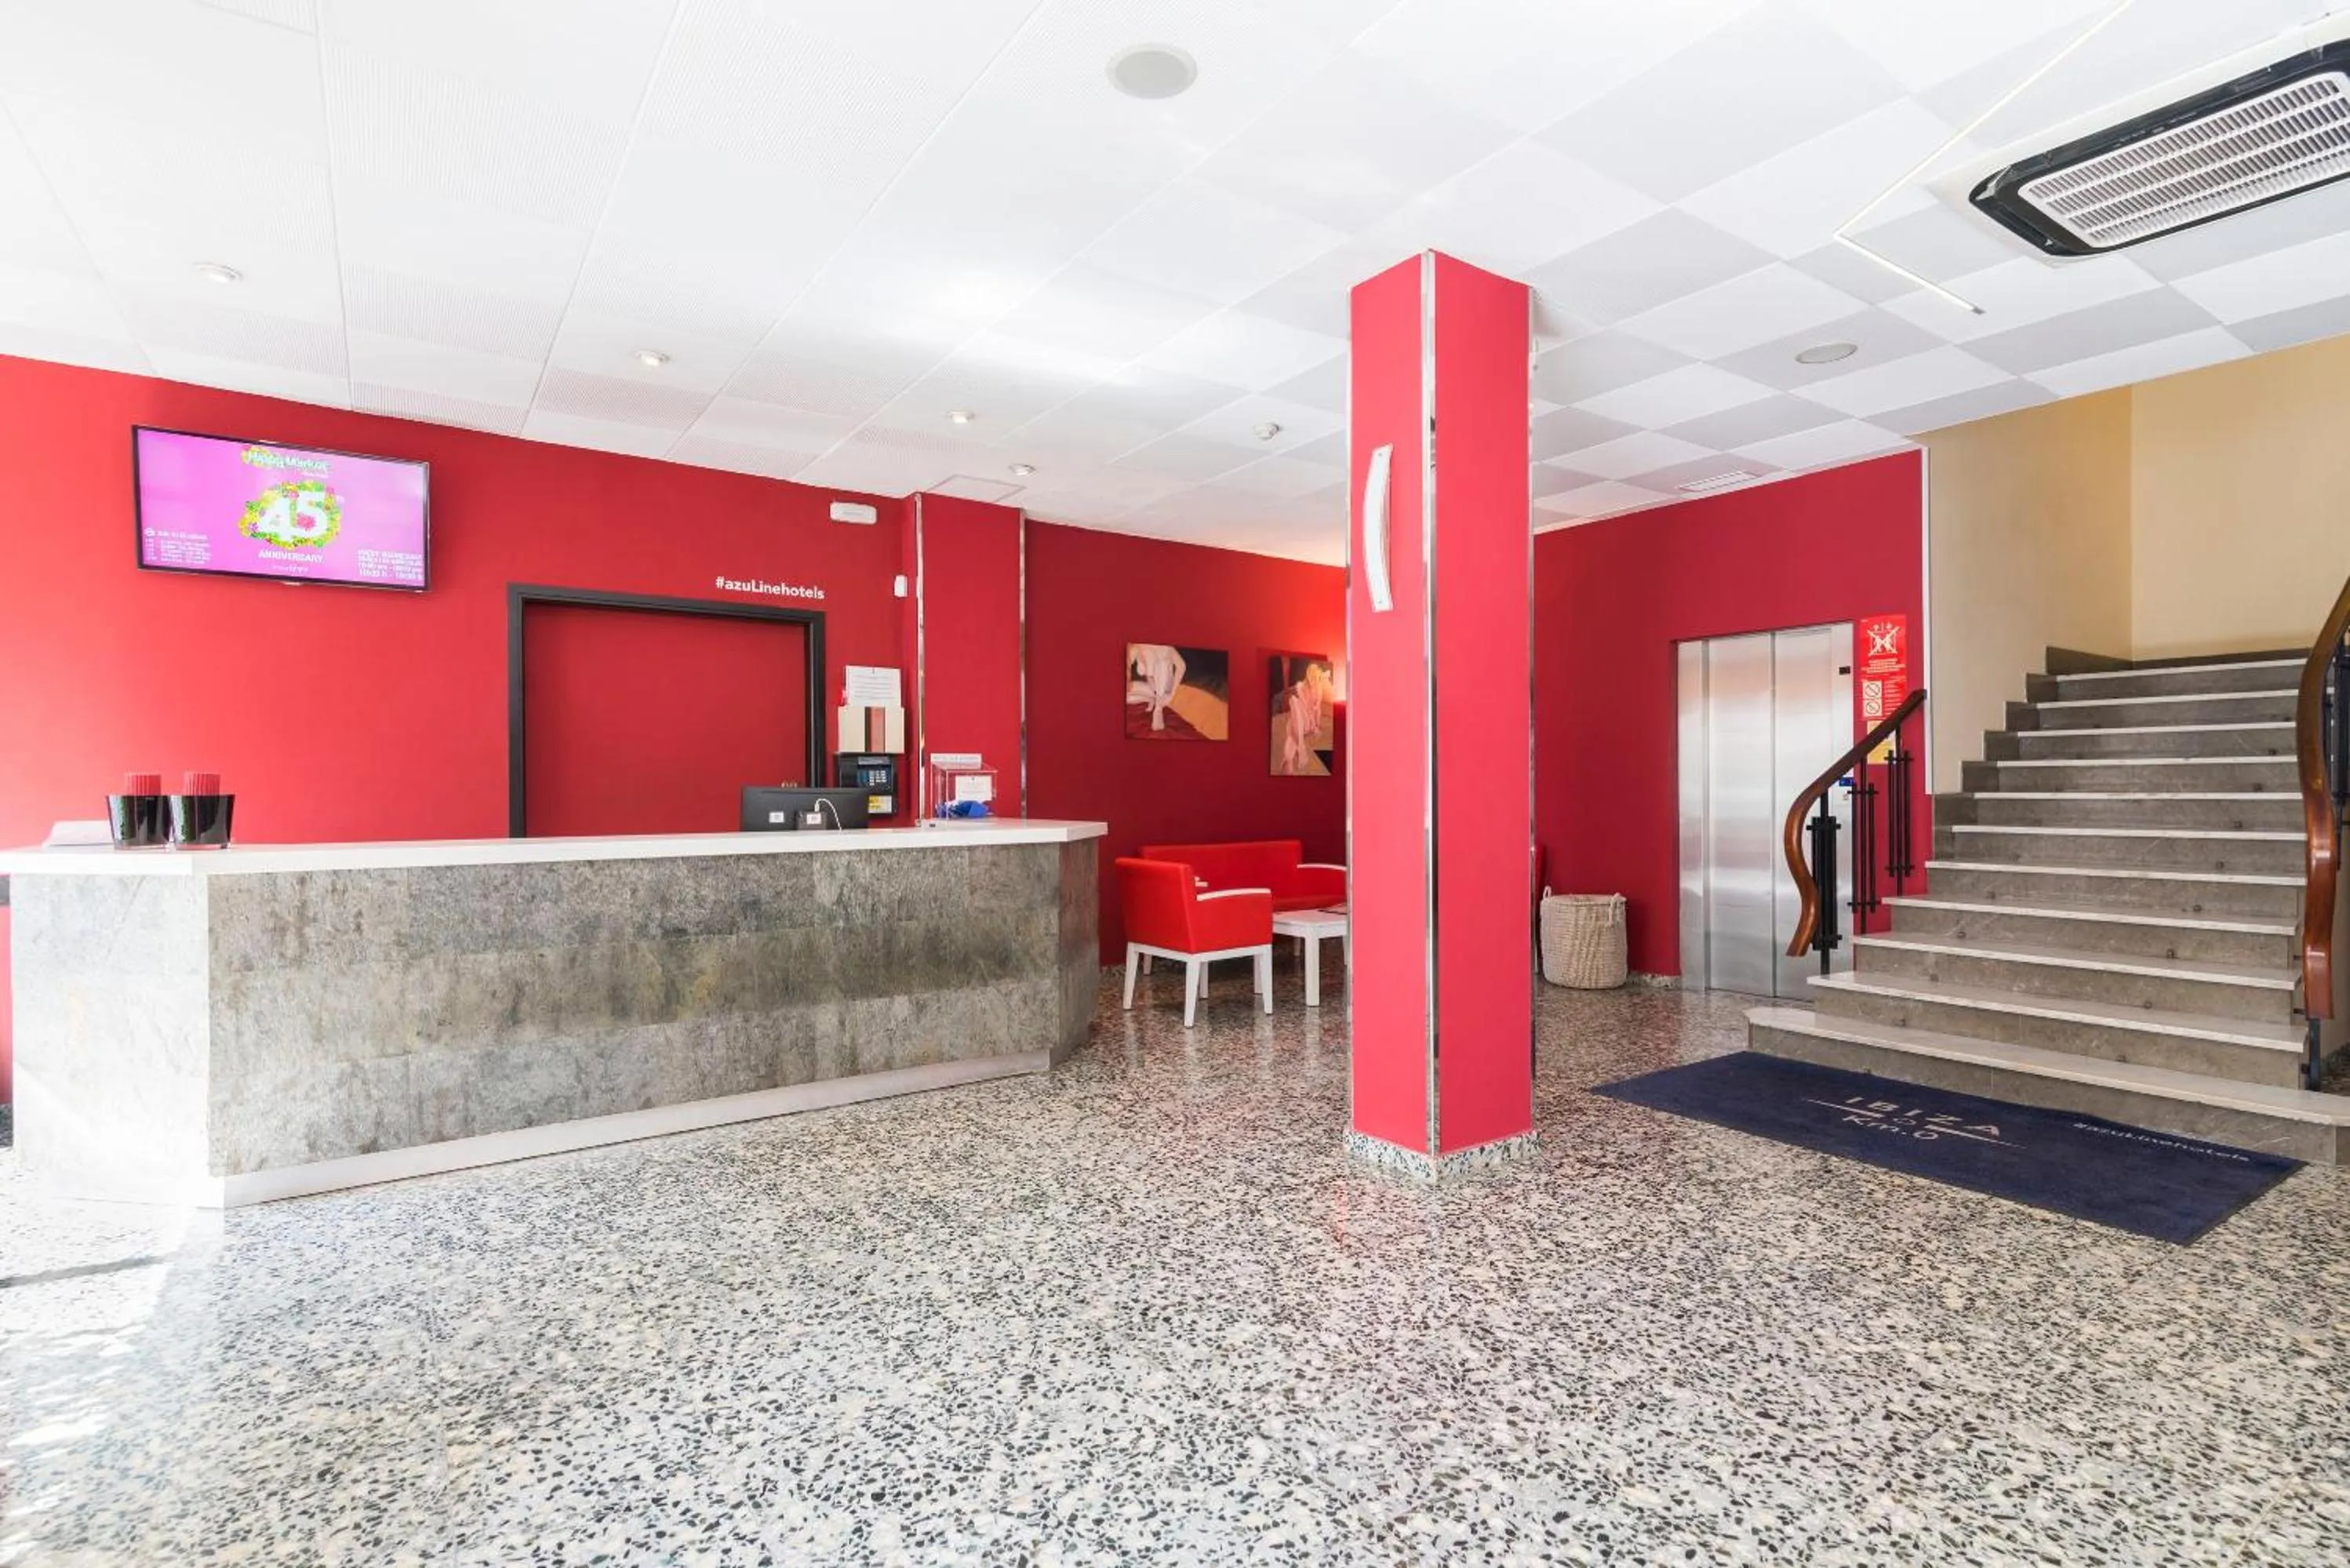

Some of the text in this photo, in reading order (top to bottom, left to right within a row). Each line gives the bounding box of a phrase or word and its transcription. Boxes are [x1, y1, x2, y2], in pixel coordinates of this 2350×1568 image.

[258, 491, 329, 541] 45
[257, 549, 325, 563] ANNIVERSARY
[715, 576, 825, 599] #azuLinehotels
[1845, 1097, 2000, 1137] IBIZA
